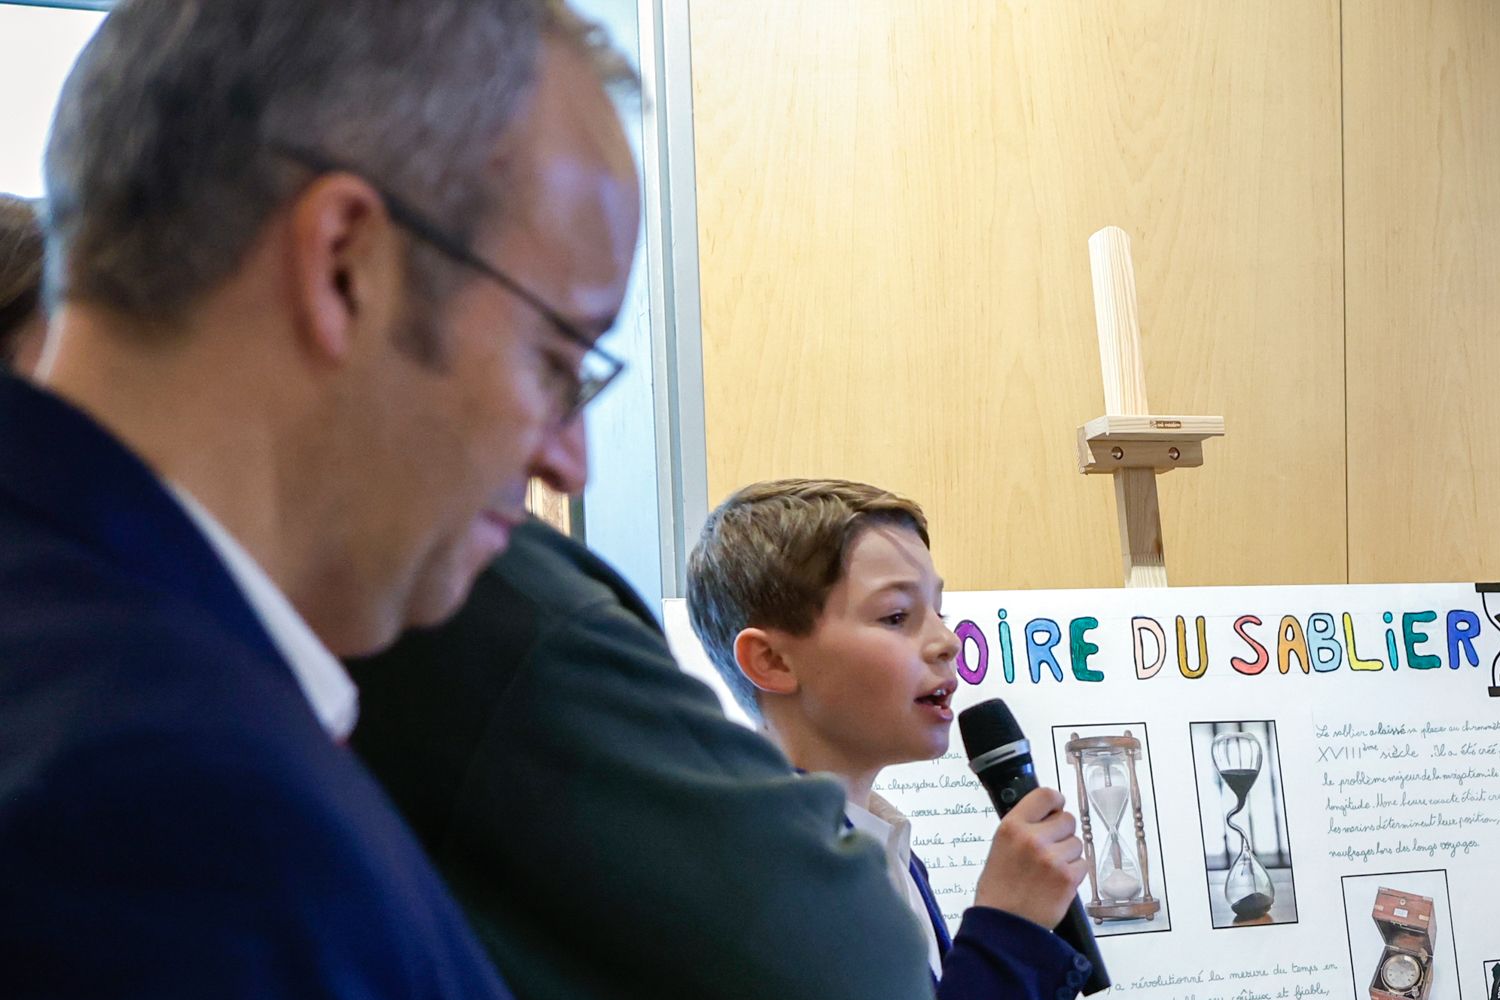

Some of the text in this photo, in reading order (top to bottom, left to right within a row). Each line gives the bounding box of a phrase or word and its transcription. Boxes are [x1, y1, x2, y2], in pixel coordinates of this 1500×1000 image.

[1131, 614, 1209, 681] DU
[1380, 744, 1419, 759] siècle
[1322, 772, 1335, 786] le
[1338, 771, 1387, 793] problème
[981, 806, 997, 819] pa
[912, 832, 985, 848] durée précise
[1130, 970, 1204, 990] révolutionné
[1208, 971, 1226, 982] la
[1229, 969, 1269, 979] mesure
[1273, 963, 1288, 975] du
[1291, 962, 1318, 975] temps
[1276, 987, 1289, 999] et
